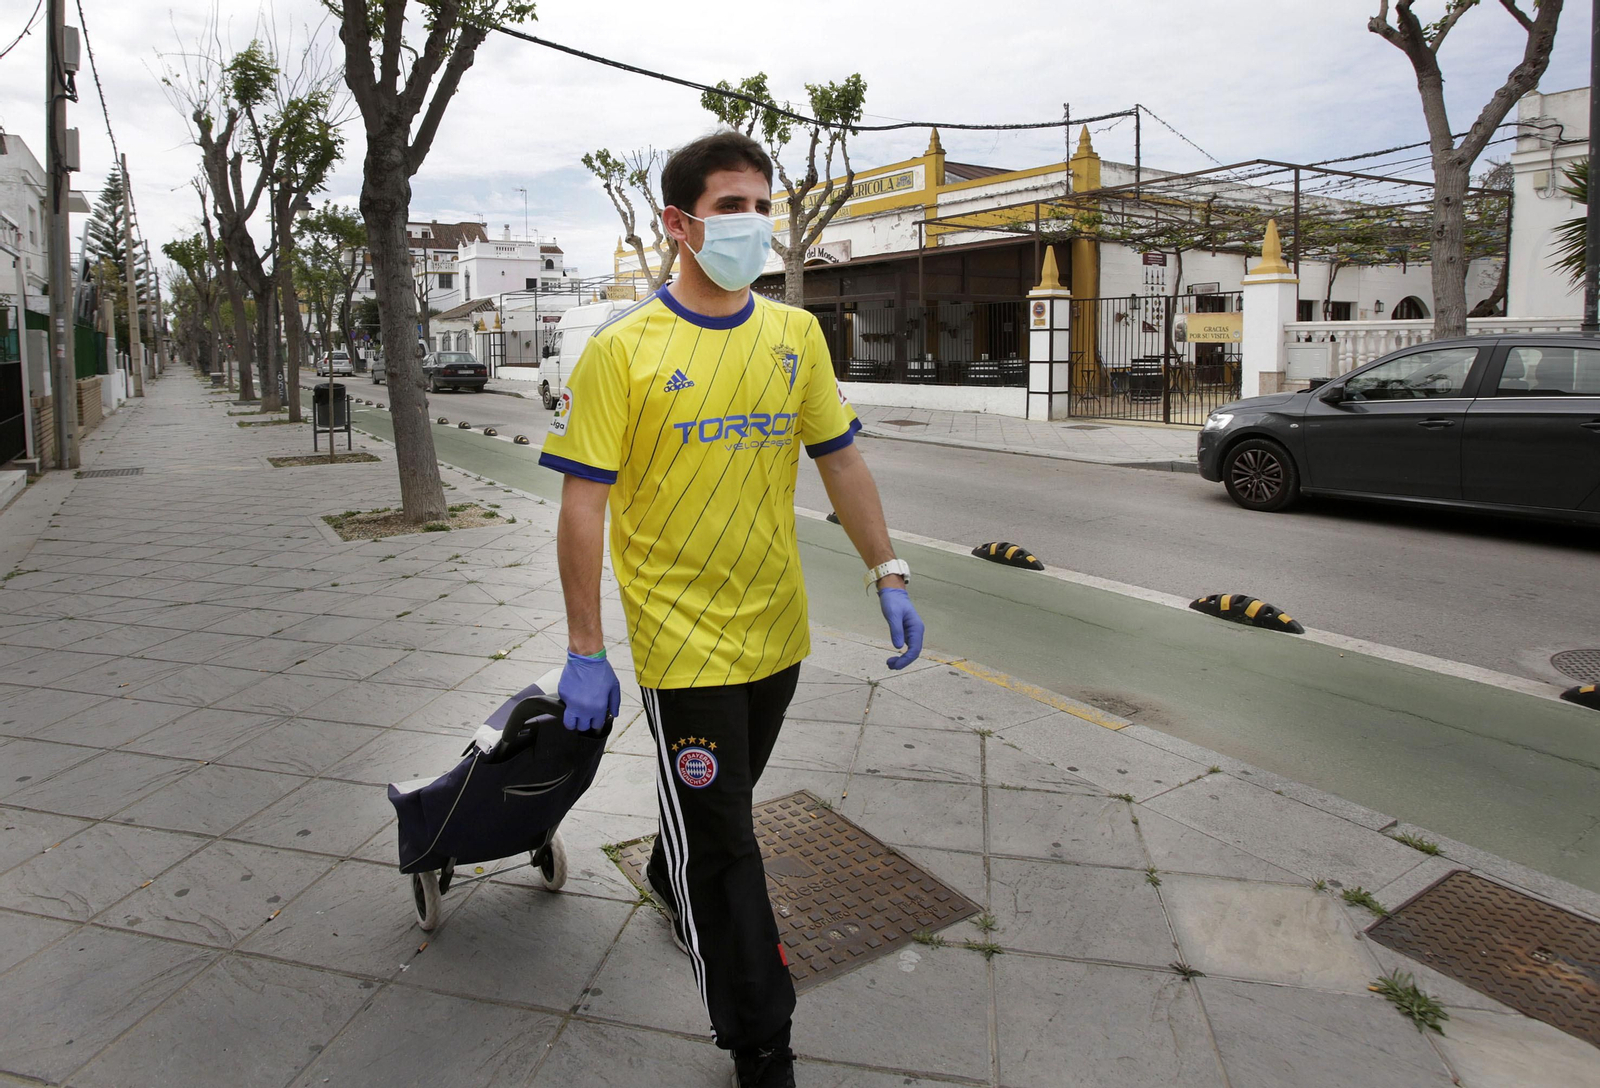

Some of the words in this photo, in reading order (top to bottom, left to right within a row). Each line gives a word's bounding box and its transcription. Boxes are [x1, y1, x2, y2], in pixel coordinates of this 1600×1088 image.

[807, 247, 816, 258] del
[664, 380, 694, 392] adidas
[674, 412, 798, 444] TORROT
[687, 753, 711, 765] BAYERN
